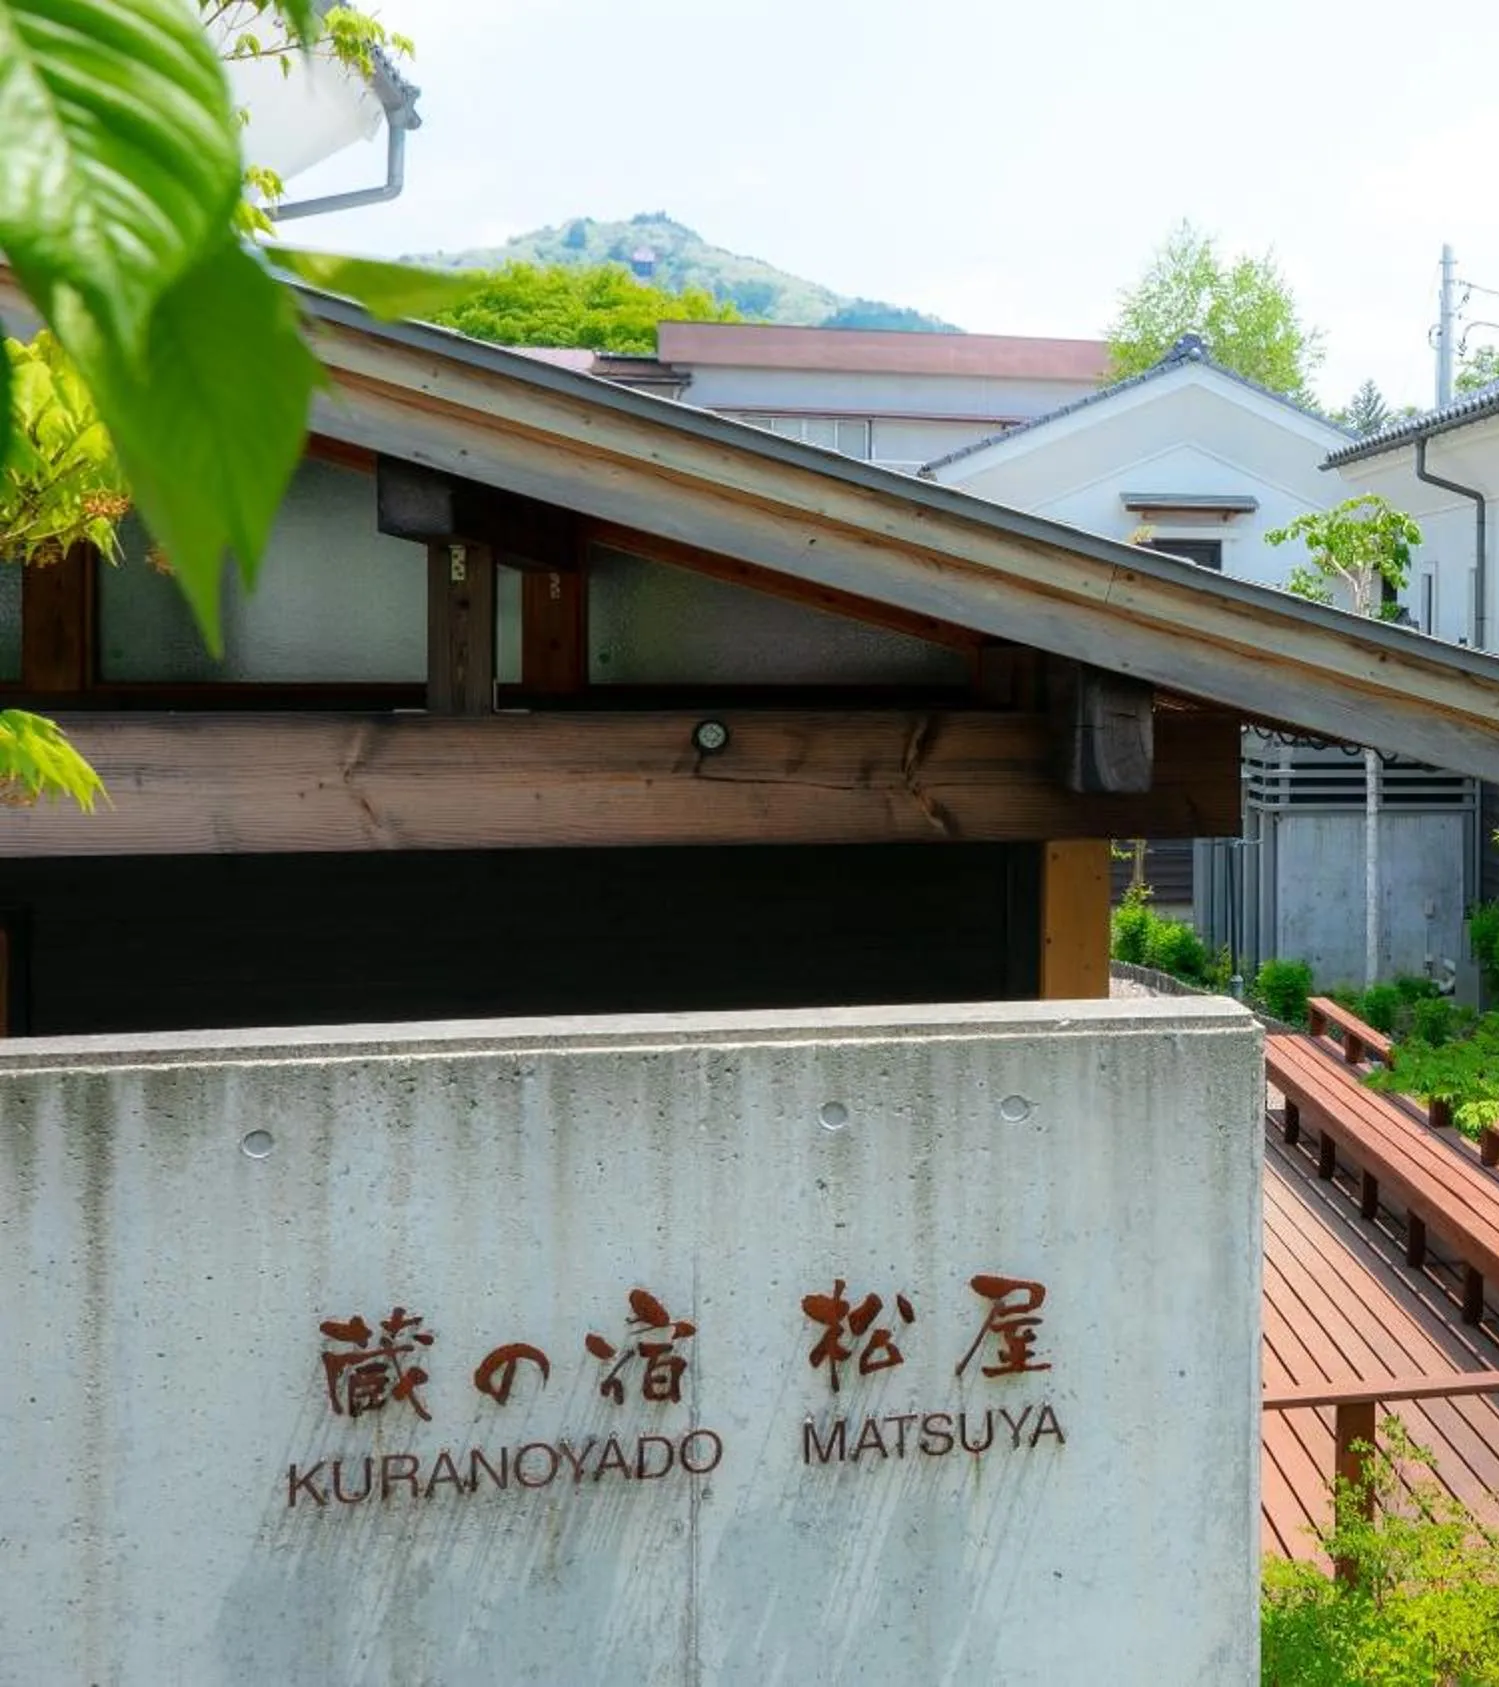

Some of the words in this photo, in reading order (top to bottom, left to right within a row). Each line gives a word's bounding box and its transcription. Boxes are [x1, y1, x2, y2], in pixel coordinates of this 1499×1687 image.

[321, 1288, 695, 1421] 蔵の宿
[802, 1274, 1053, 1391] 松屋
[288, 1429, 724, 1508] KURANOYADO
[802, 1405, 1066, 1465] MATSUYA
